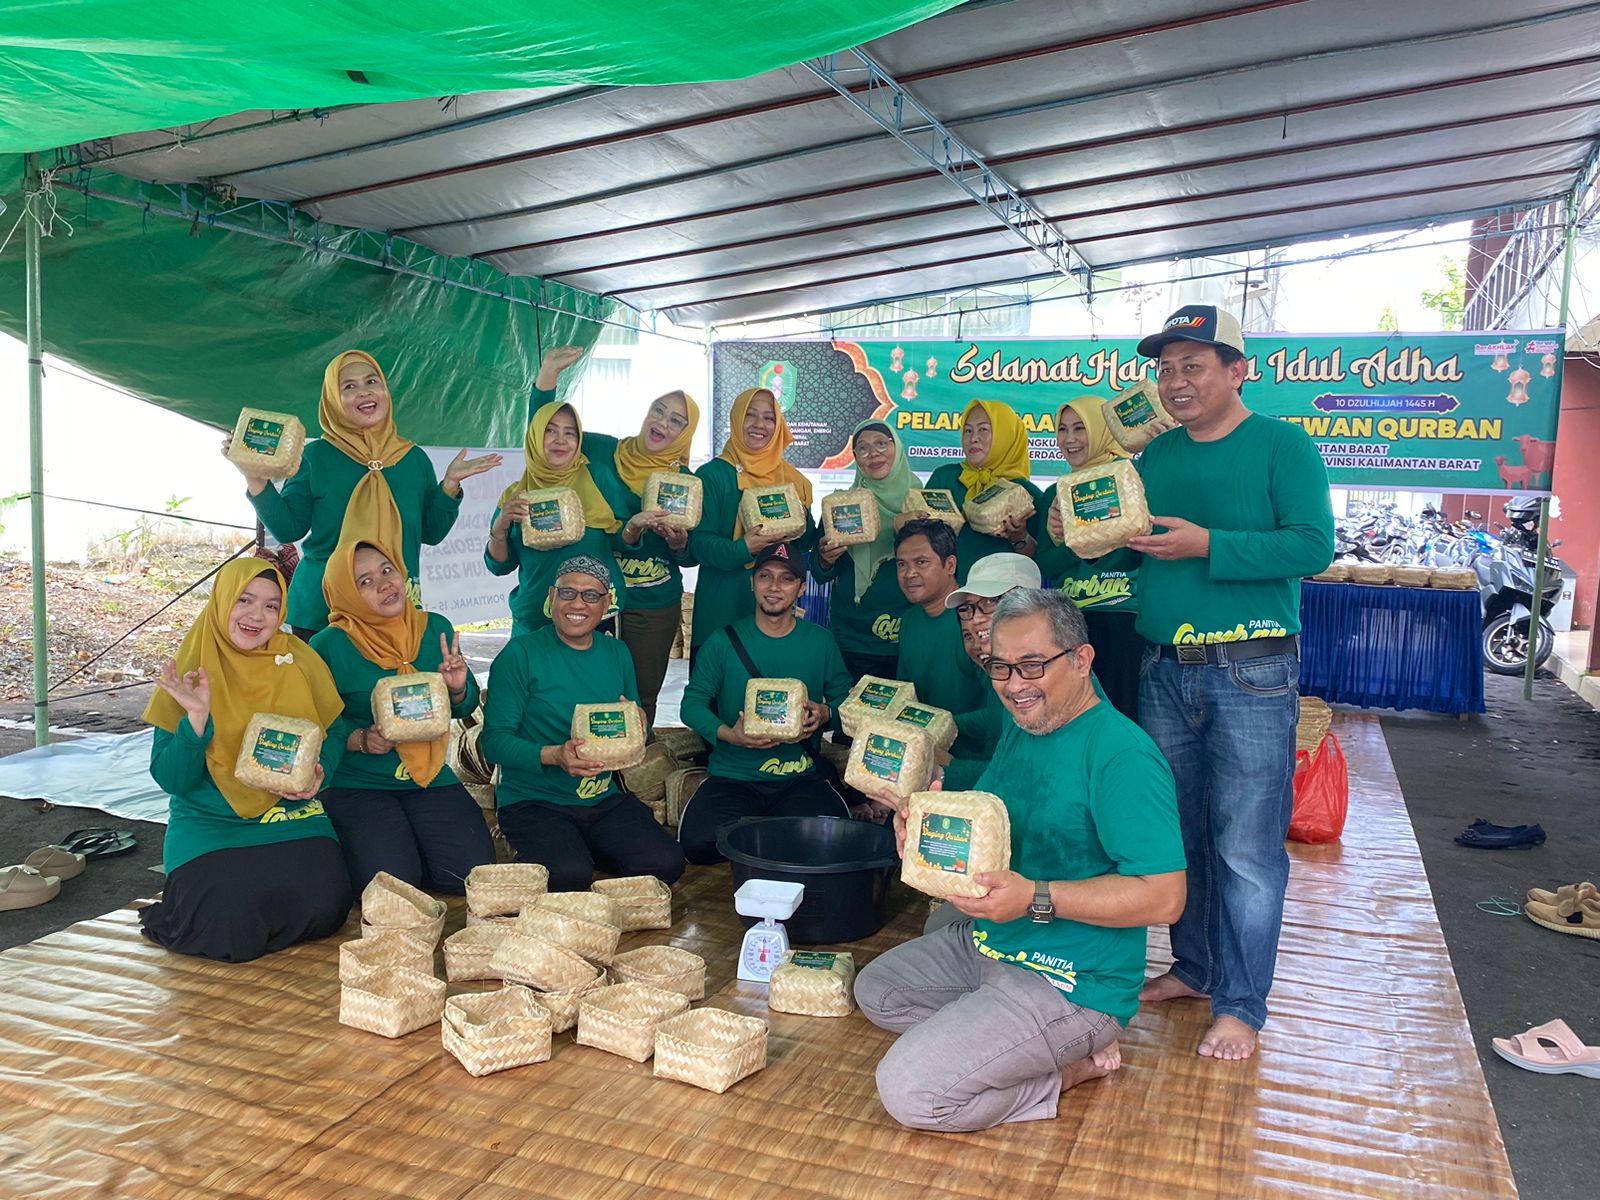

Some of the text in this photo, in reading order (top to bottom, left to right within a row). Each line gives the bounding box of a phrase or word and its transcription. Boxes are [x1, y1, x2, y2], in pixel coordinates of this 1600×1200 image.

[949, 344, 1084, 385] Selamat
[1266, 346, 1347, 385] Idul
[1349, 346, 1463, 389] Adha
[1335, 398, 1436, 409] 10 DZULHIJJAH 1445 H
[1377, 417, 1502, 441] QURBAN
[909, 447, 939, 457] DINAS
[1349, 444, 1388, 455] BARAT
[1358, 458, 1437, 470] KALIMANTAN
[1439, 460, 1480, 471] BARAT
[1248, 619, 1282, 629] PANITIA
[1031, 951, 1074, 971] PANITIA
